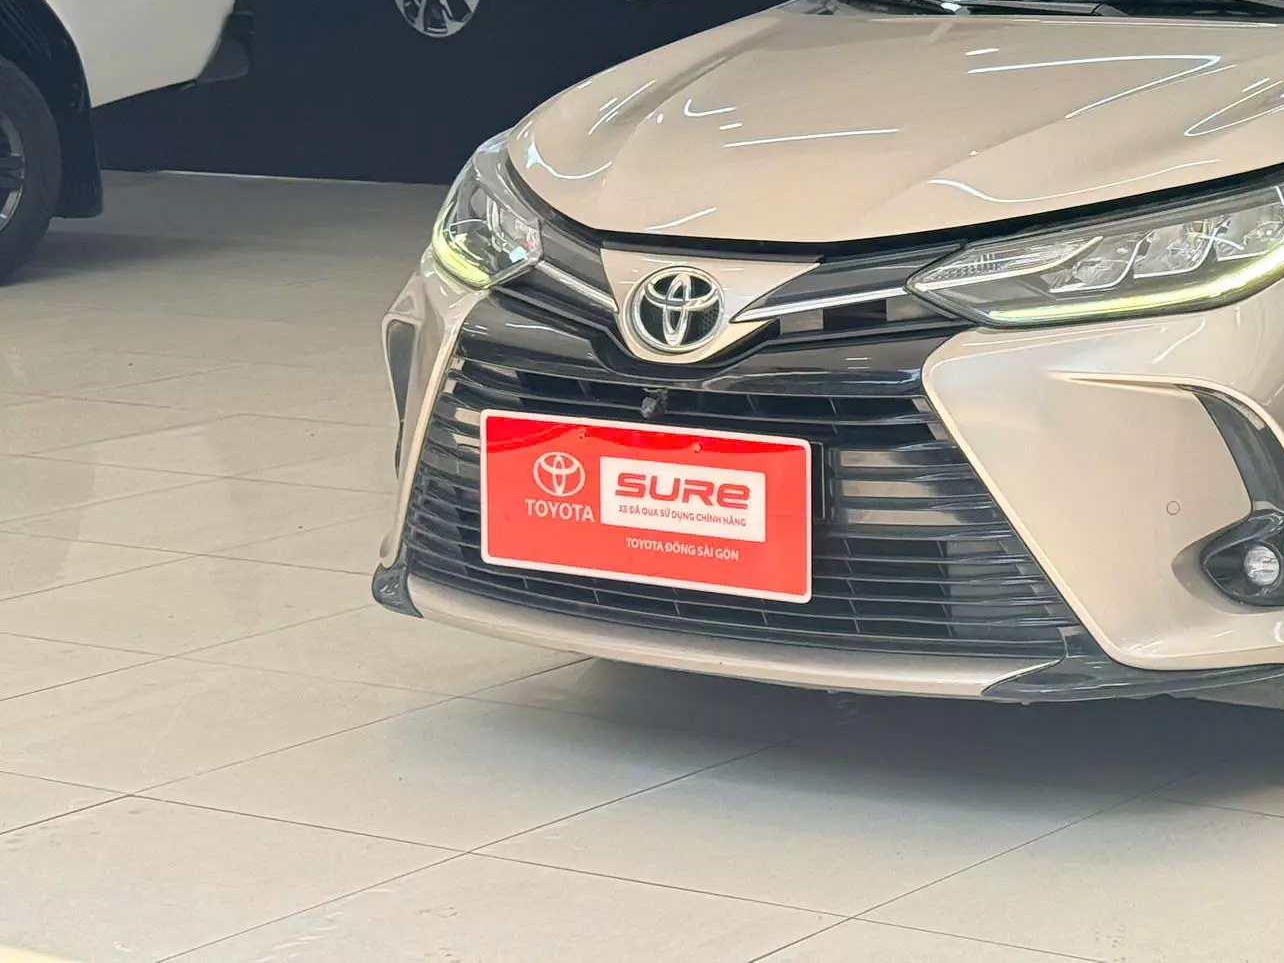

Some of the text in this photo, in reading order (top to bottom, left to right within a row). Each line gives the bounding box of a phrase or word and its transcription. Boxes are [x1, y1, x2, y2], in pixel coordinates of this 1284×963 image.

[525, 498, 595, 523] TOYOTA
[618, 504, 628, 513] XE
[642, 507, 659, 517] QUA
[625, 537, 664, 551] TOYOTA
[665, 541, 696, 555] ĐÔNG
[715, 547, 739, 561] GÒN
